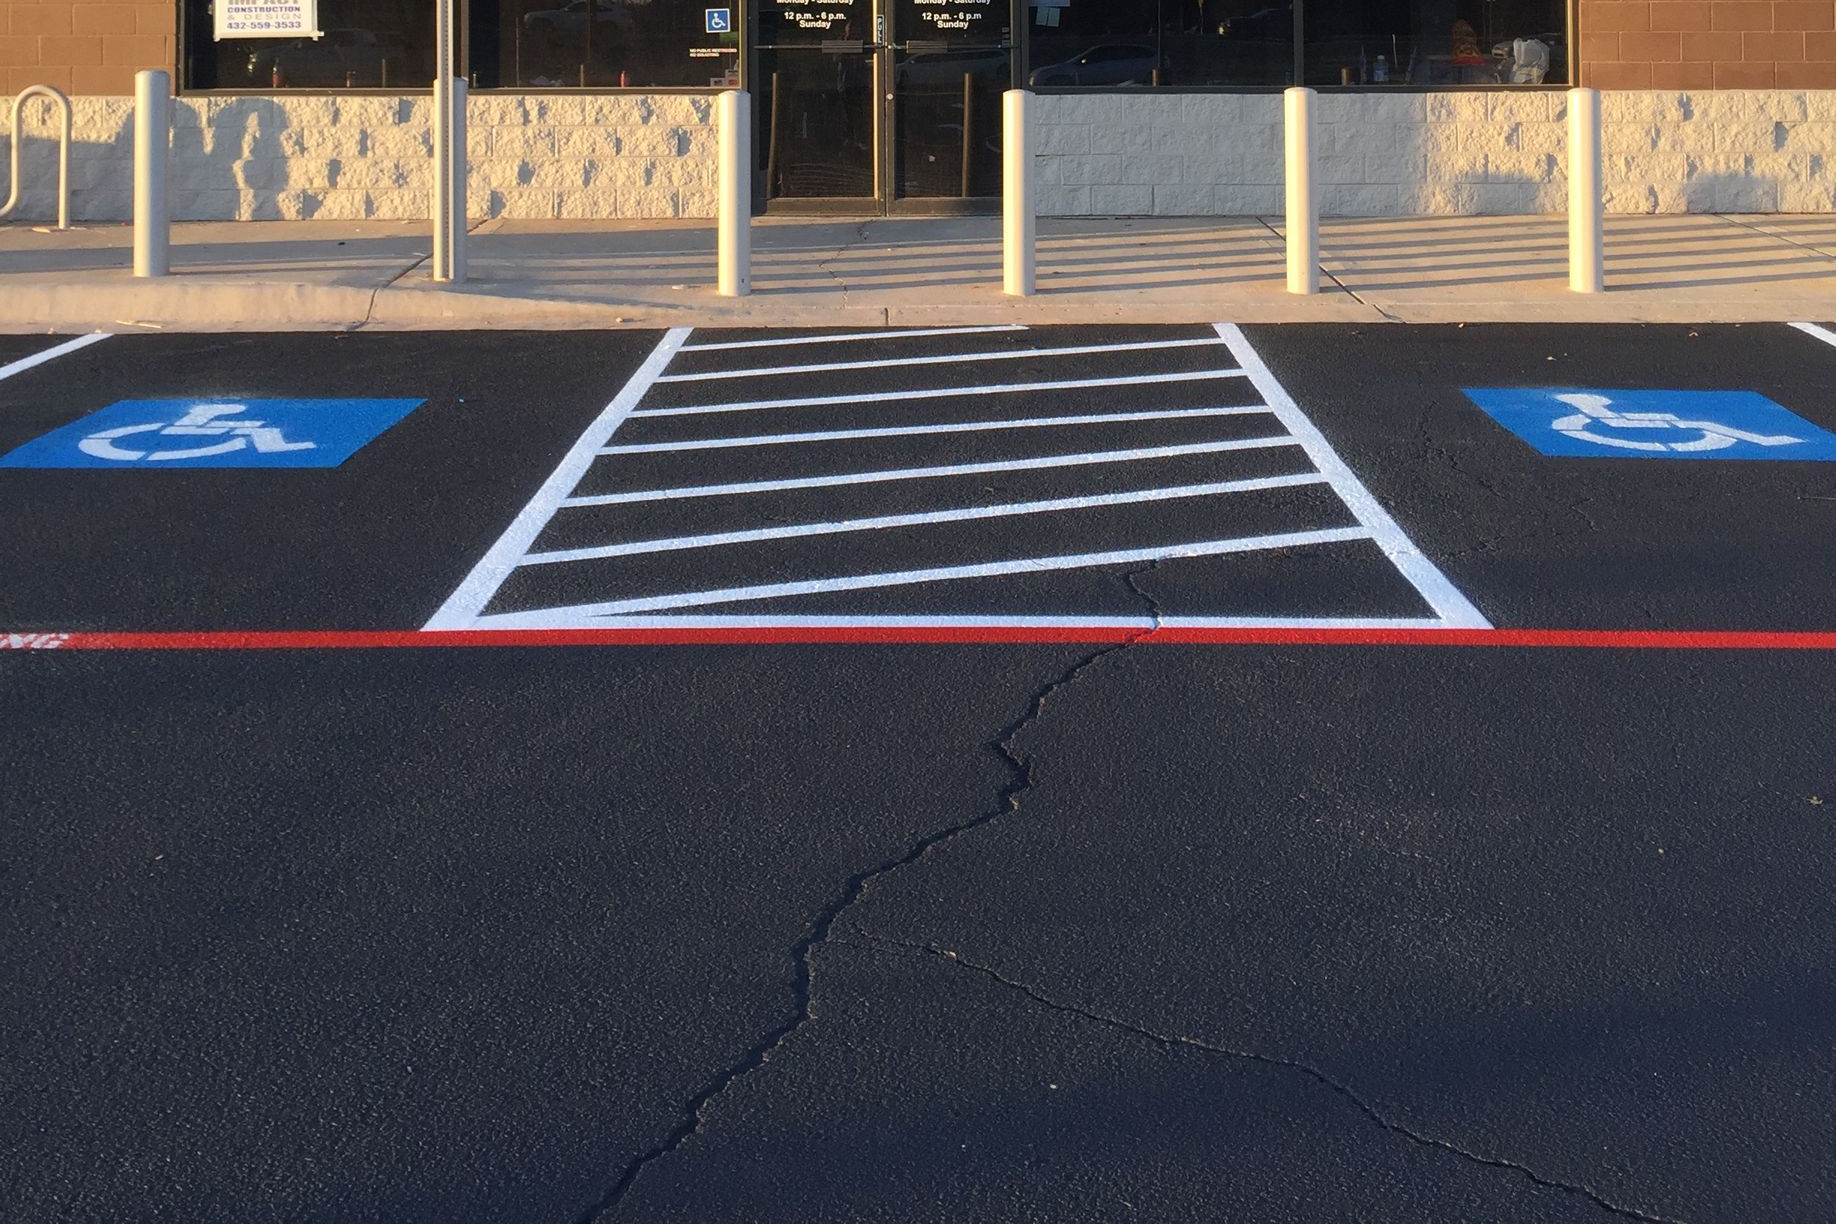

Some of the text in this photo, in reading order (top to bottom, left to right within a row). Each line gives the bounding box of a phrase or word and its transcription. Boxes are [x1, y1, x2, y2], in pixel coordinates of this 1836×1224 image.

[227, 6, 301, 14] CONSTRUCTION
[784, 12, 794, 20] 12
[796, 13, 814, 21] p.m.
[821, 12, 827, 20] 6
[828, 13, 846, 21] p.m.
[922, 12, 932, 20] 12
[934, 13, 952, 21] p.m.
[958, 12, 964, 20] 6
[227, 21, 302, 30] 432-559-3533
[799, 20, 831, 30] Sunday
[937, 21, 969, 30] Sunday
